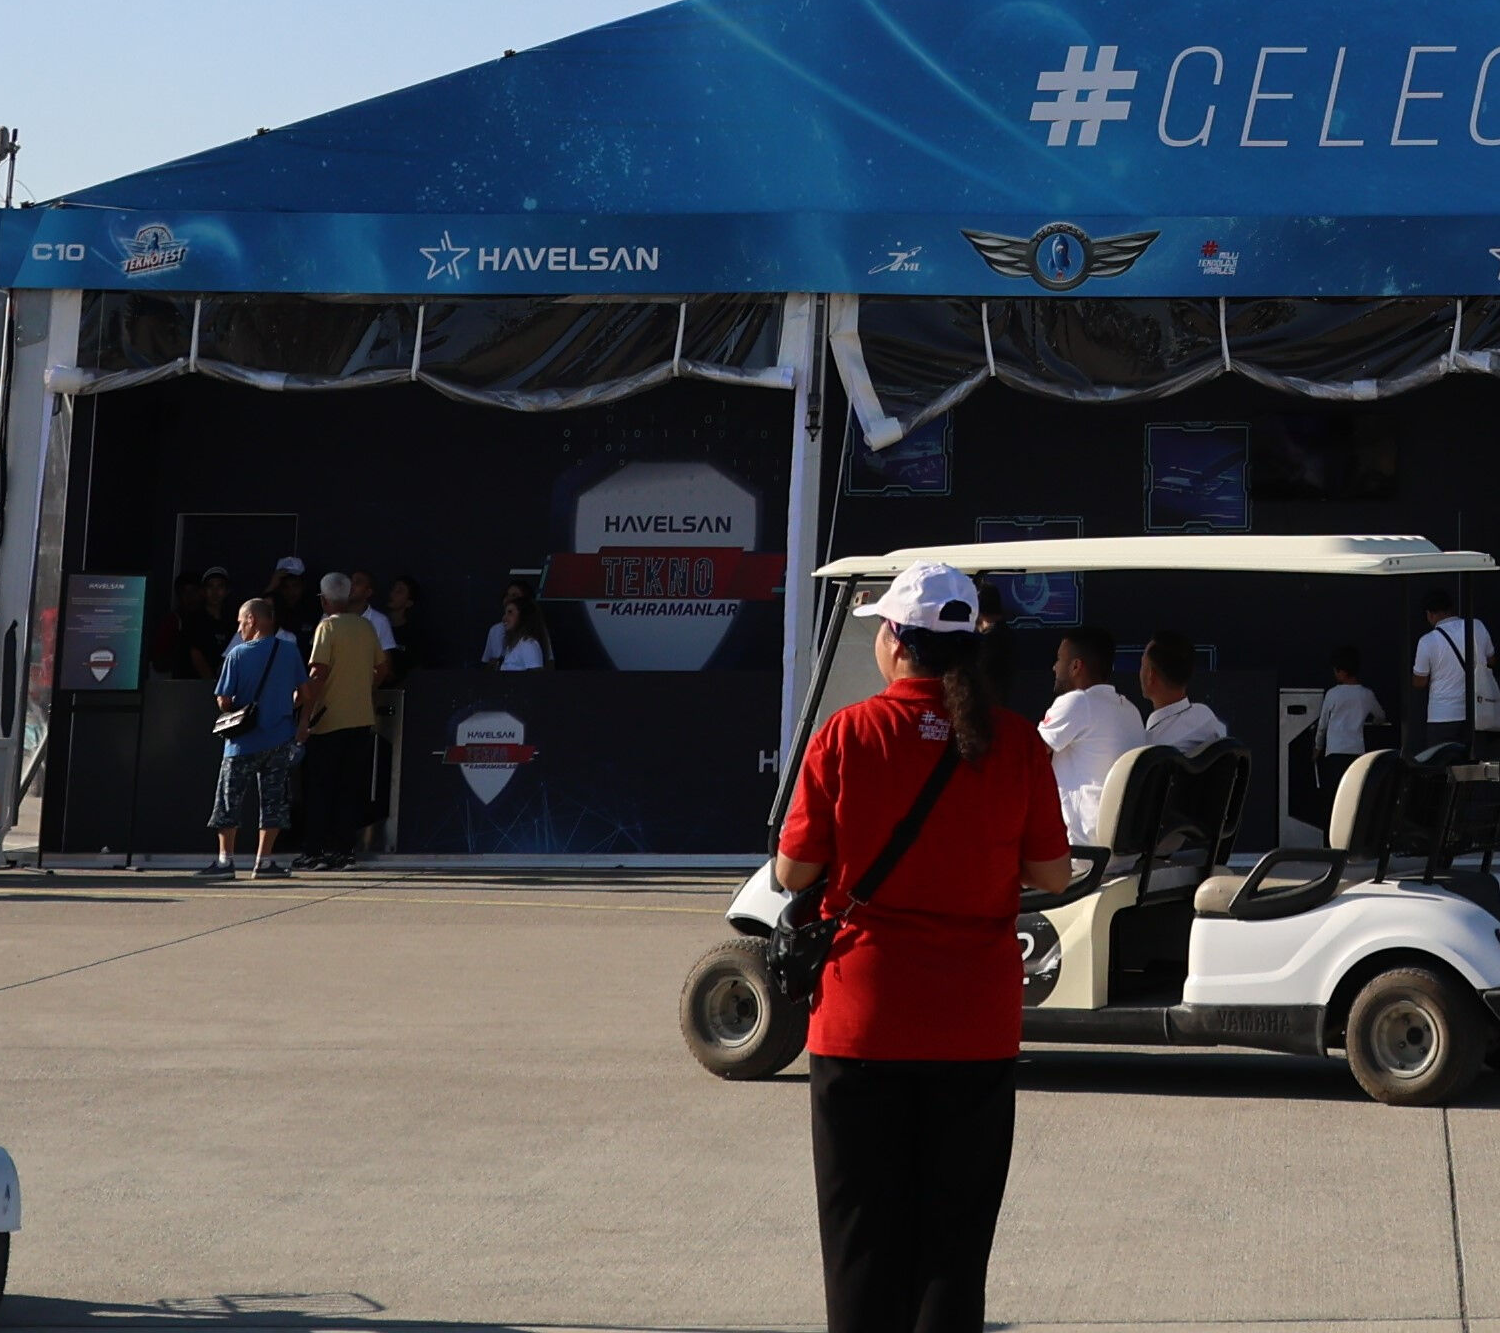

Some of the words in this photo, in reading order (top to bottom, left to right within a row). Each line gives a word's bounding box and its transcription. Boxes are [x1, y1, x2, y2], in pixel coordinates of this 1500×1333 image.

[32, 243, 85, 261] C10
[123, 247, 187, 273] TEKNOFEST
[478, 247, 659, 271] HAVELSAN
[604, 515, 732, 533] HAVELSAN
[602, 556, 714, 598] TEKNO
[610, 602, 739, 617] KAHRAMANLAR
[467, 731, 516, 739] HAVELSAN
[1217, 1010, 1293, 1033] YAMAHA
